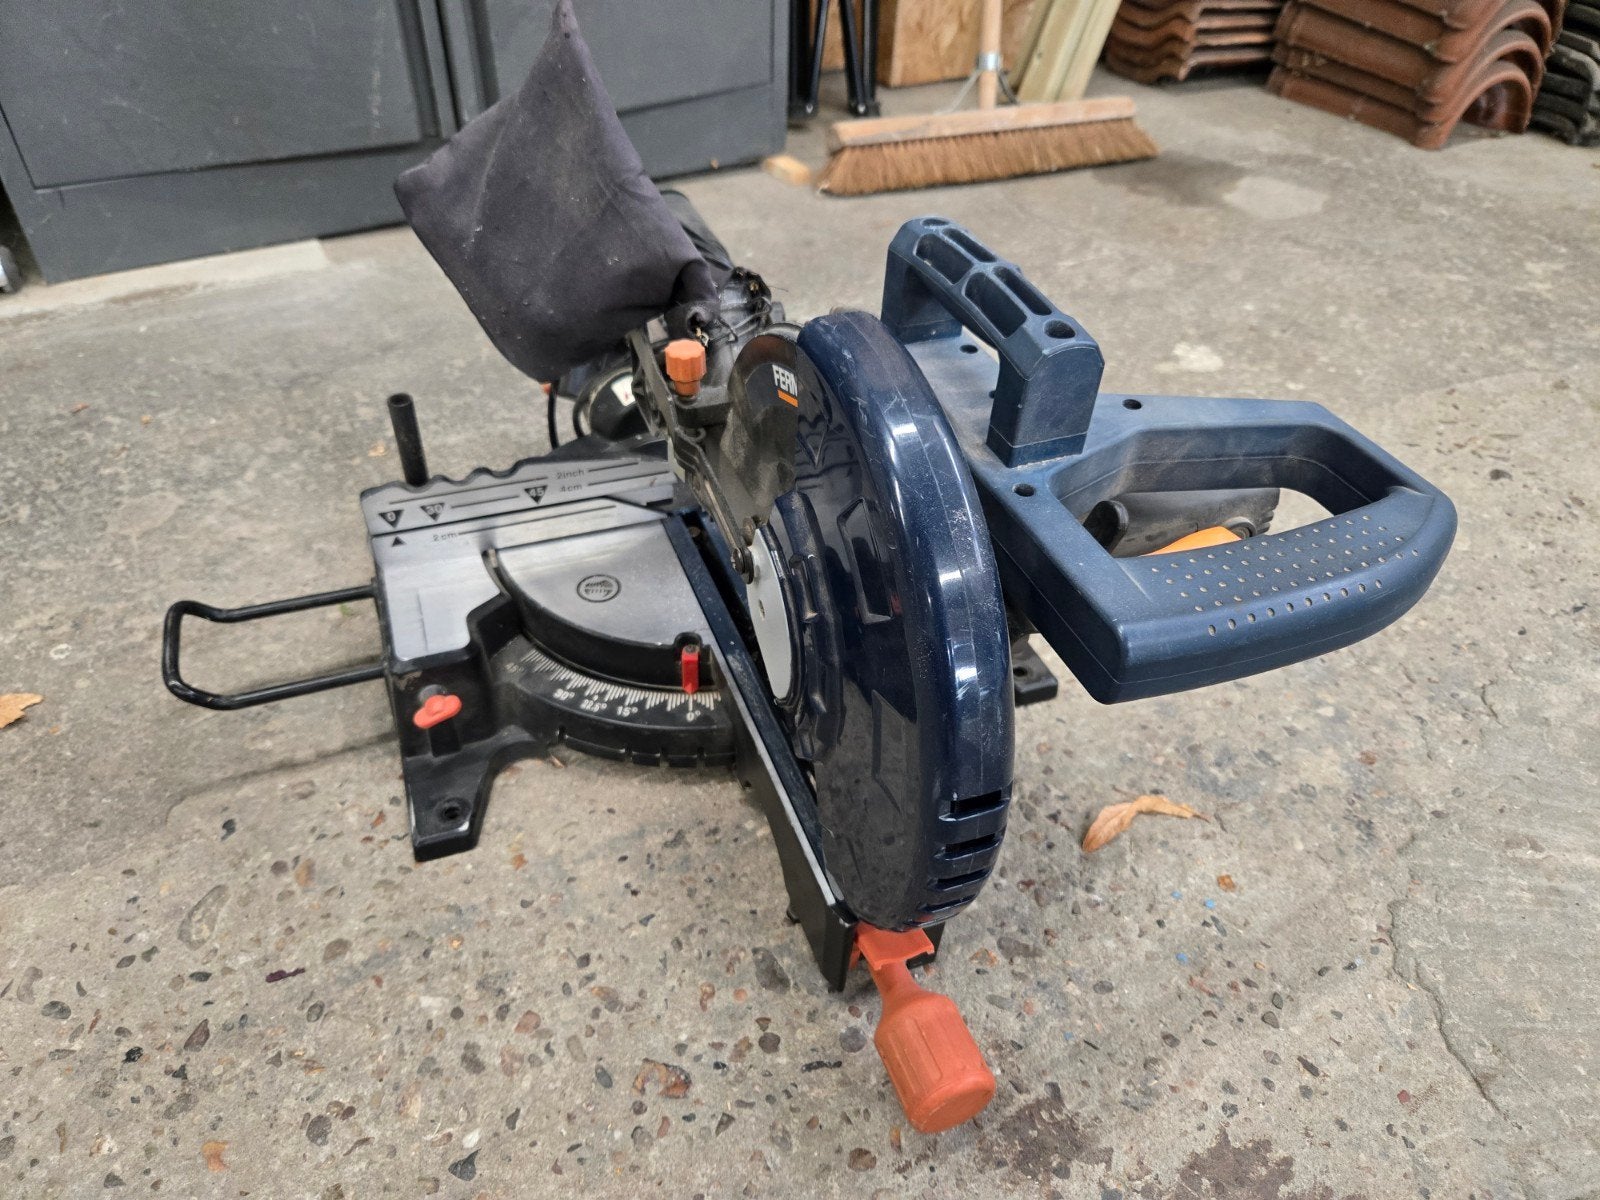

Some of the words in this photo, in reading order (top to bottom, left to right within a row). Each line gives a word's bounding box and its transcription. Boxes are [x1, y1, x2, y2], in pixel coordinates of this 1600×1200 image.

[556, 468, 585, 480] 2inch
[529, 487, 545, 498] 45
[424, 503, 443, 515] 30
